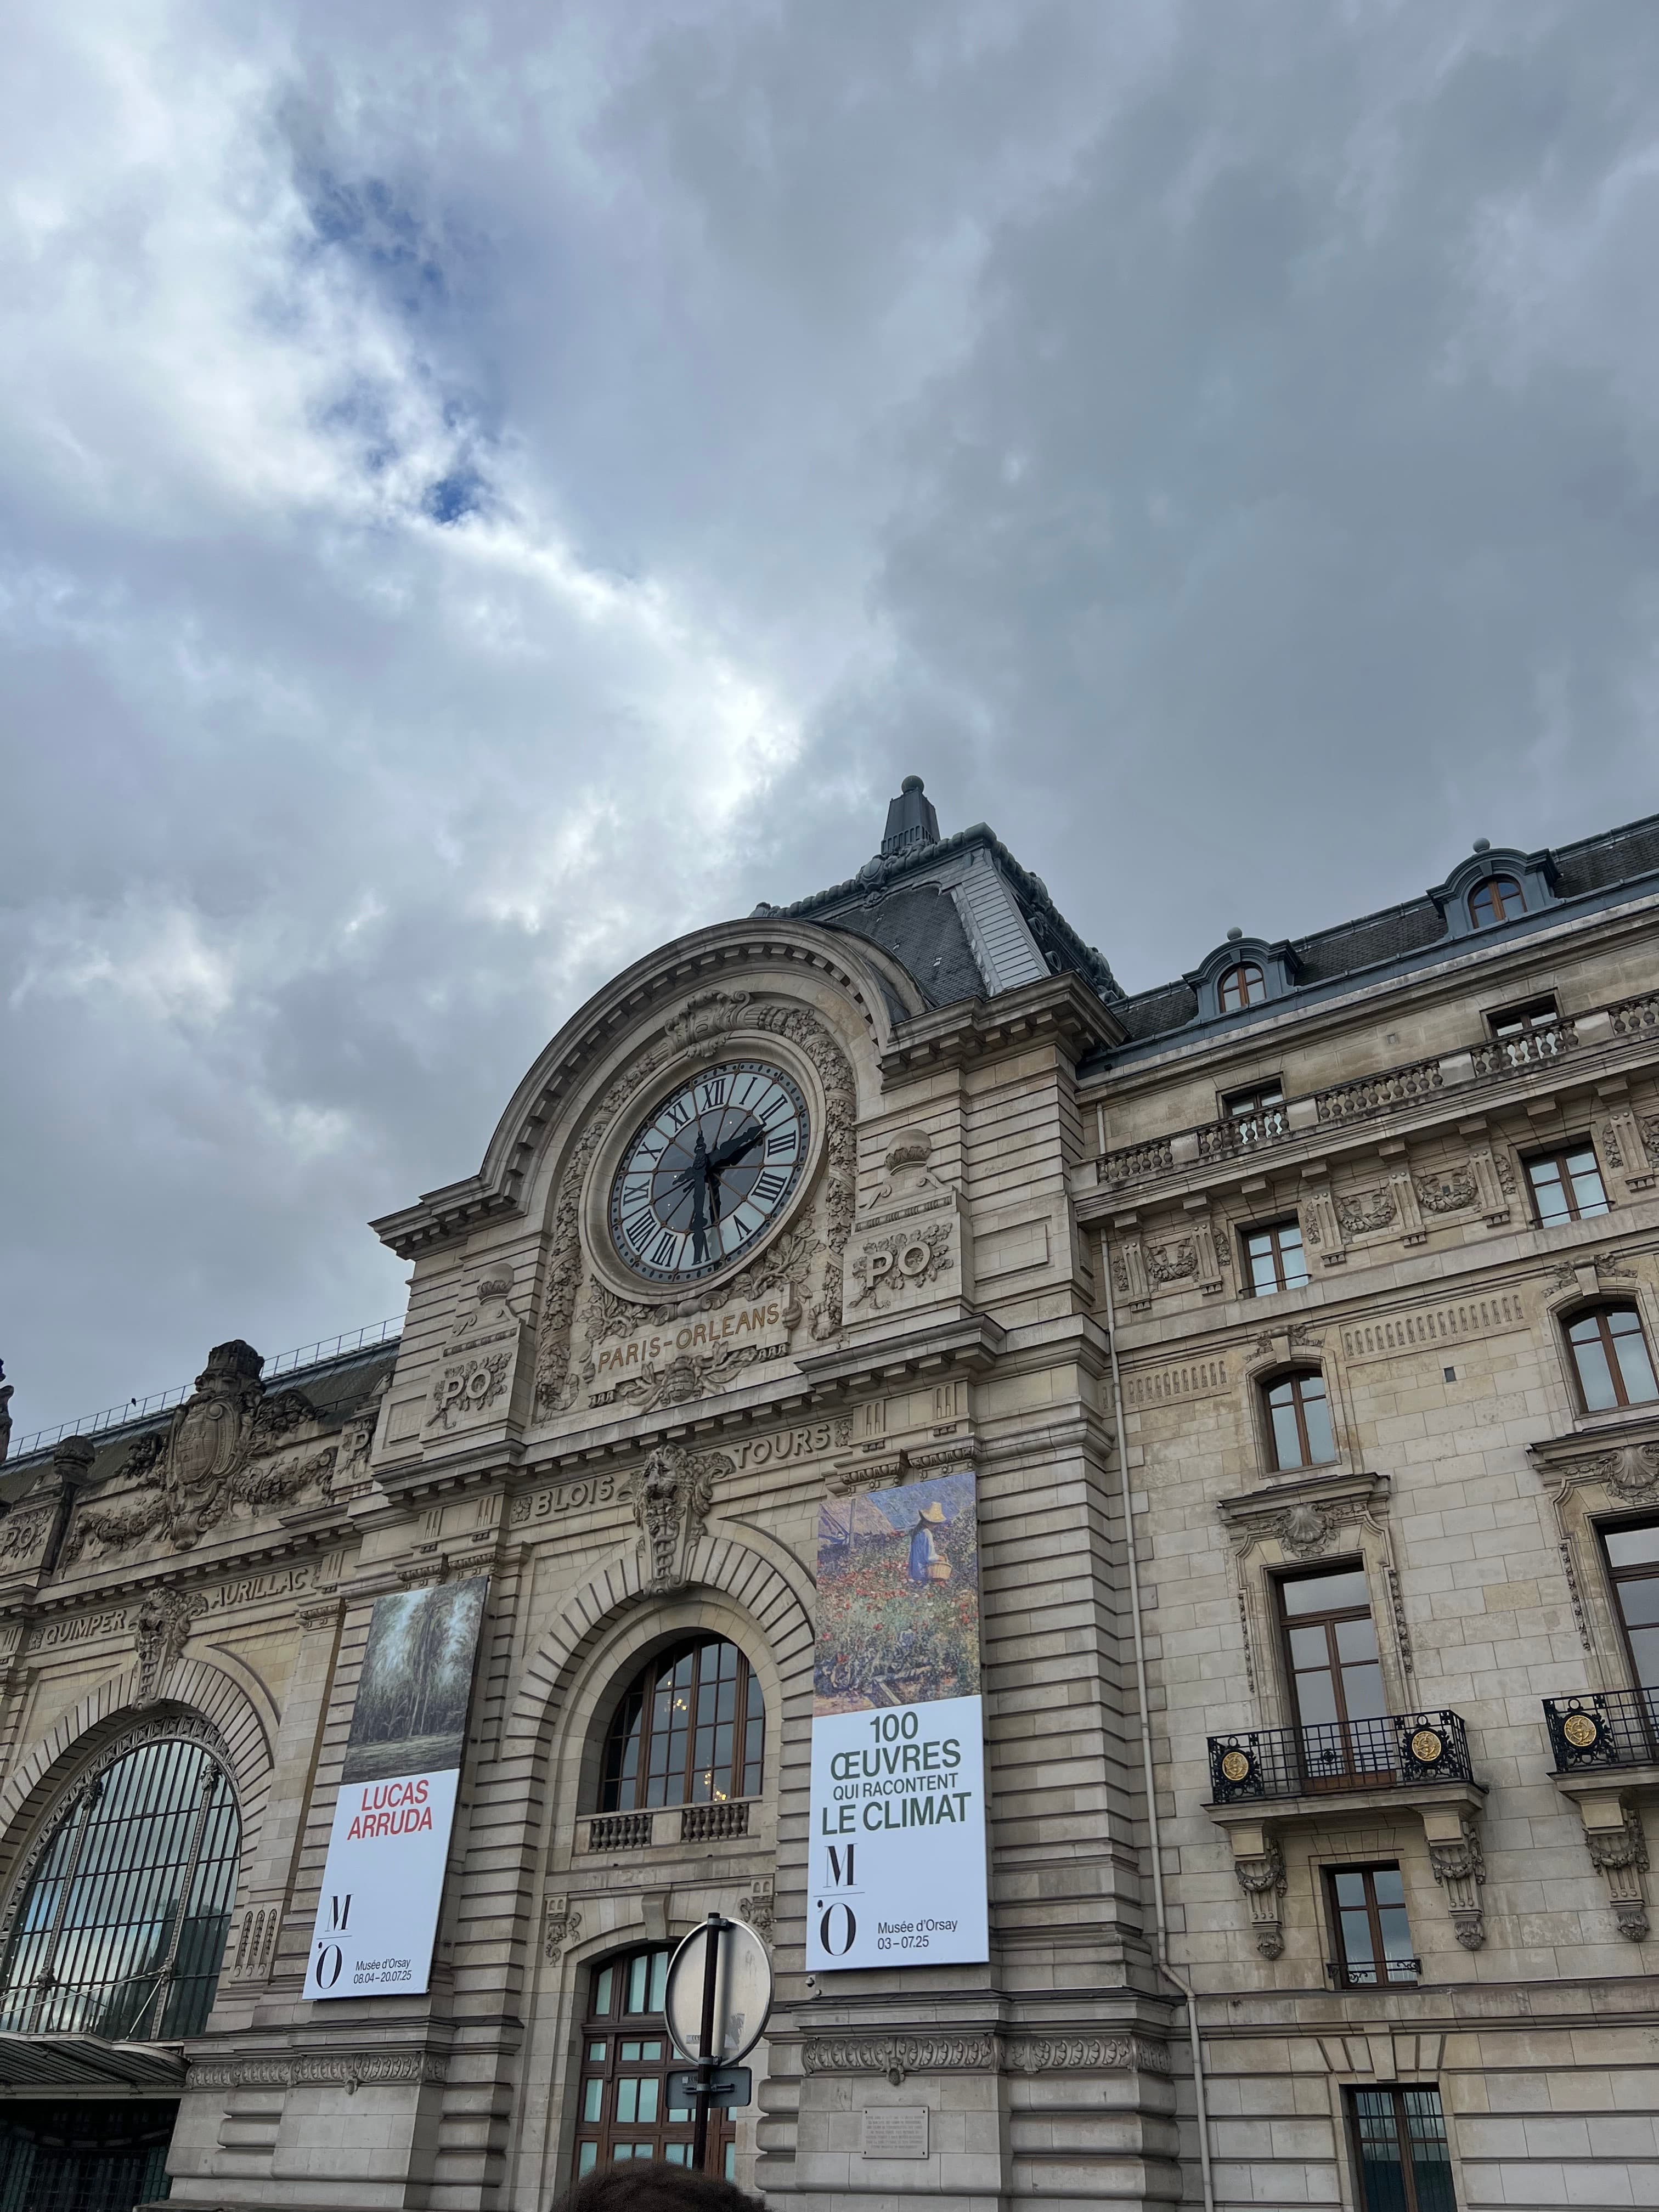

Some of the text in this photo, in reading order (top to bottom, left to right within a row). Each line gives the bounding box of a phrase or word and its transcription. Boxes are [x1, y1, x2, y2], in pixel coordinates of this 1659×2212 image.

[701, 1078, 726, 1112] XII
[739, 1077, 758, 1105] I
[664, 1101, 691, 1132] XI
[759, 1094, 788, 1125] II
[636, 1142, 664, 1161] X
[768, 1130, 796, 1157] III
[623, 1179, 651, 1206] IX
[751, 1171, 787, 1204] IIII
[626, 1209, 657, 1252] VIII
[733, 1215, 752, 1241] V
[650, 1232, 678, 1267] VII
[866, 1240, 930, 1290] PO
[598, 1303, 780, 1373] PARIS-ORLEANS
[441, 1368, 491, 1410] PO
[733, 1424, 831, 1469] TOURS
[533, 1476, 615, 1516] BLOIS
[210, 1568, 308, 1609] AURILLAC
[44, 1610, 127, 1646] QUIMPER
[870, 1711, 918, 1743] 100
[831, 1739, 961, 1781] ŒUVRES
[362, 1780, 429, 1811] LUCAS
[833, 1773, 958, 1801] QUI RACONTENT
[347, 1807, 432, 1840] ARRUDA
[822, 1792, 972, 1835] LE CLIMAT
[823, 1843, 858, 1888] M
[325, 1894, 354, 1932] M
[878, 1919, 958, 1934] Musée d'Orsay
[878, 1937, 891, 1949] 03
[901, 1935, 929, 1948] 07.25
[356, 1958, 411, 1971] Musée d'Orsay
